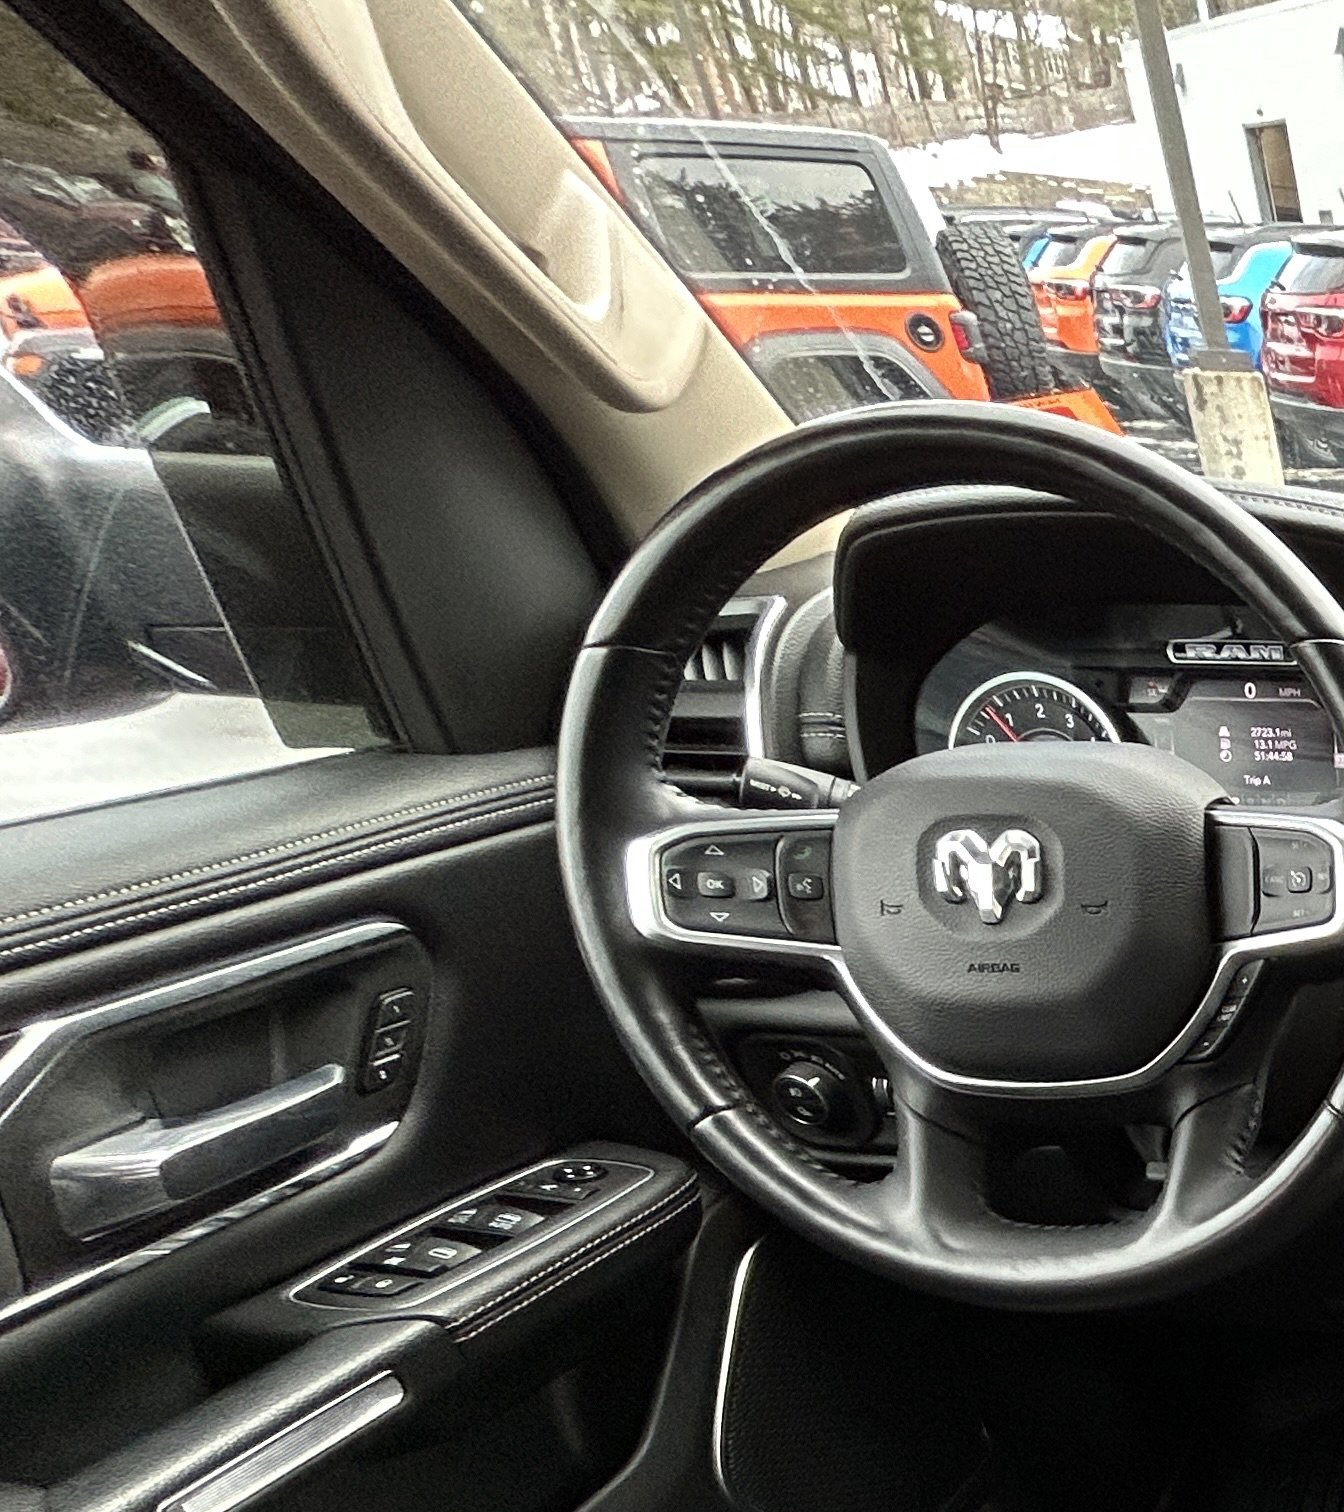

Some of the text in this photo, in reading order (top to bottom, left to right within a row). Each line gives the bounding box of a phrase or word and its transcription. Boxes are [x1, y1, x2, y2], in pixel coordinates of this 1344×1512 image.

[1185, 643, 1284, 661] RAM
[1243, 682, 1301, 699] 0 MPH
[1035, 703, 1046, 719] 2
[1005, 712, 1014, 727] 1
[1064, 713, 1075, 729] 3
[1253, 740, 1297, 751] 13.1 MPG
[1243, 775, 1272, 787] Trip A
[705, 877, 724, 889] OK
[967, 962, 1020, 974] AIRBAG
